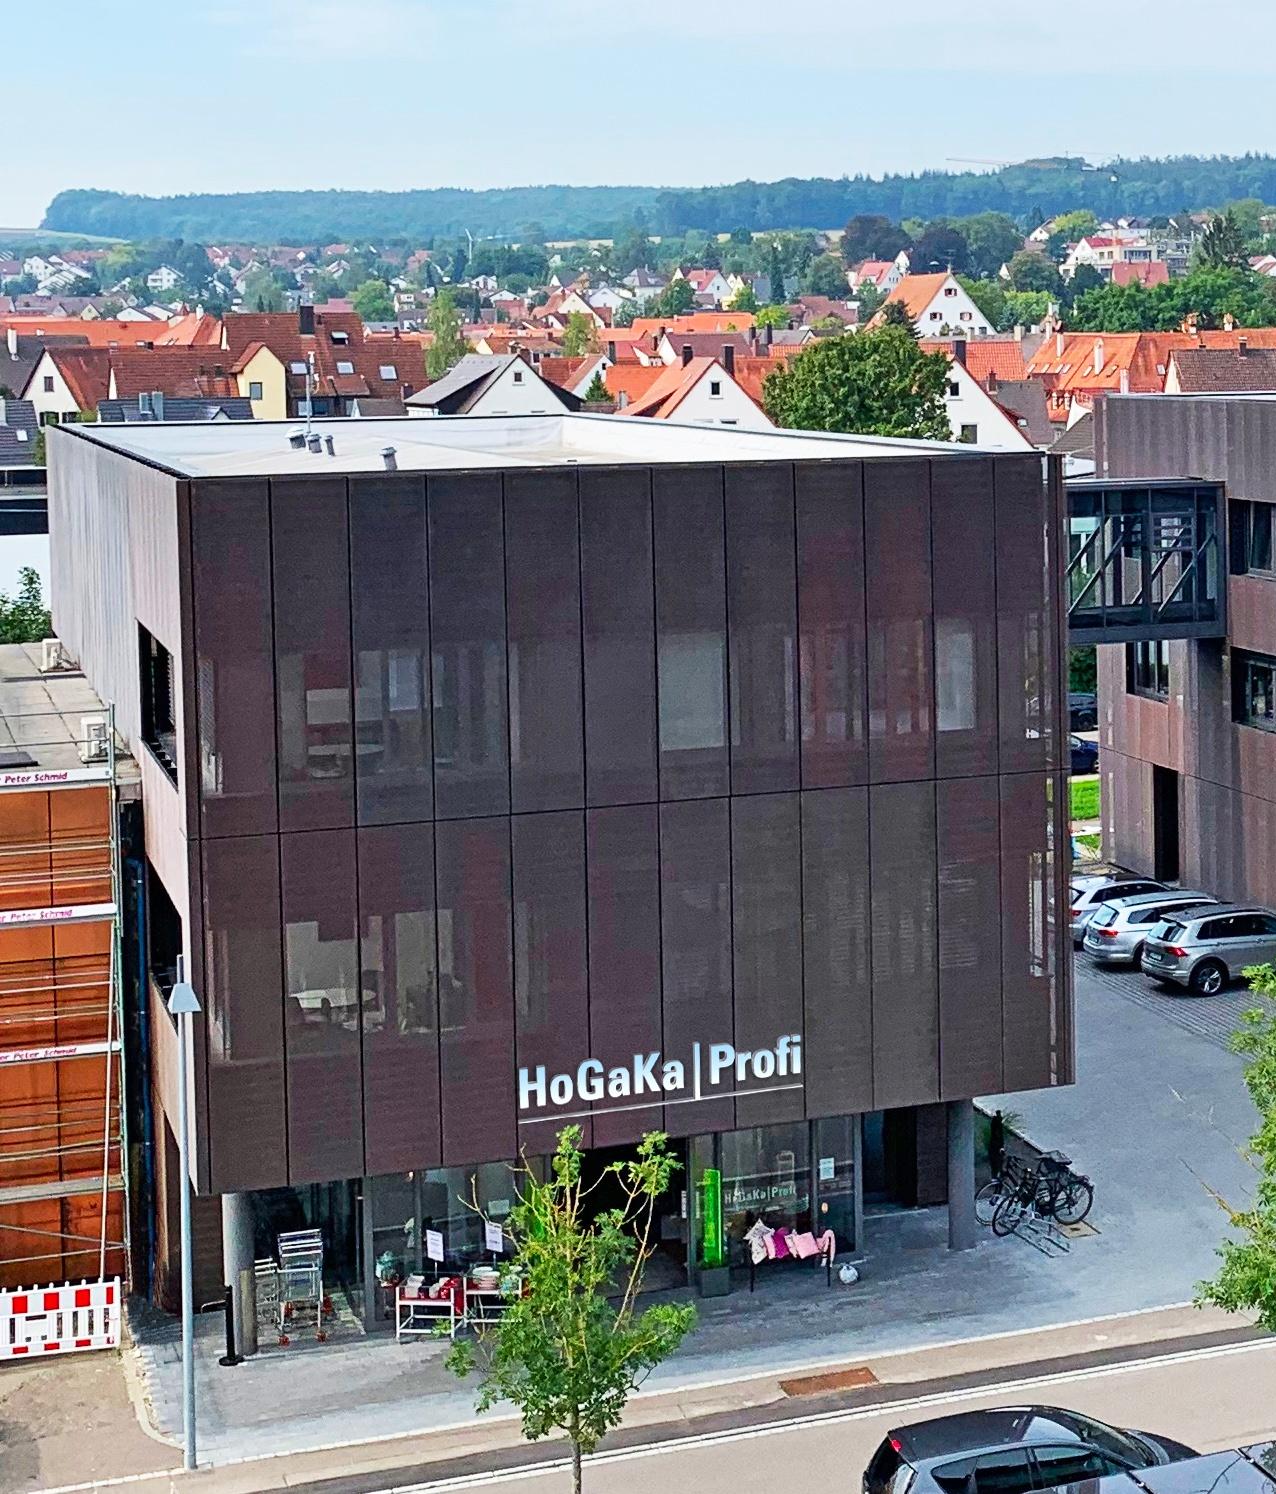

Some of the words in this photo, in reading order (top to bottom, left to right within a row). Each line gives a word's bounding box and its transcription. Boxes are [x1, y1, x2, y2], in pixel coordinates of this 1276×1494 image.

[4, 774, 32, 784] Peter
[34, 771, 68, 782] Schmid
[519, 1051, 685, 1109] HoGaKa
[709, 1034, 802, 1085] Profi
